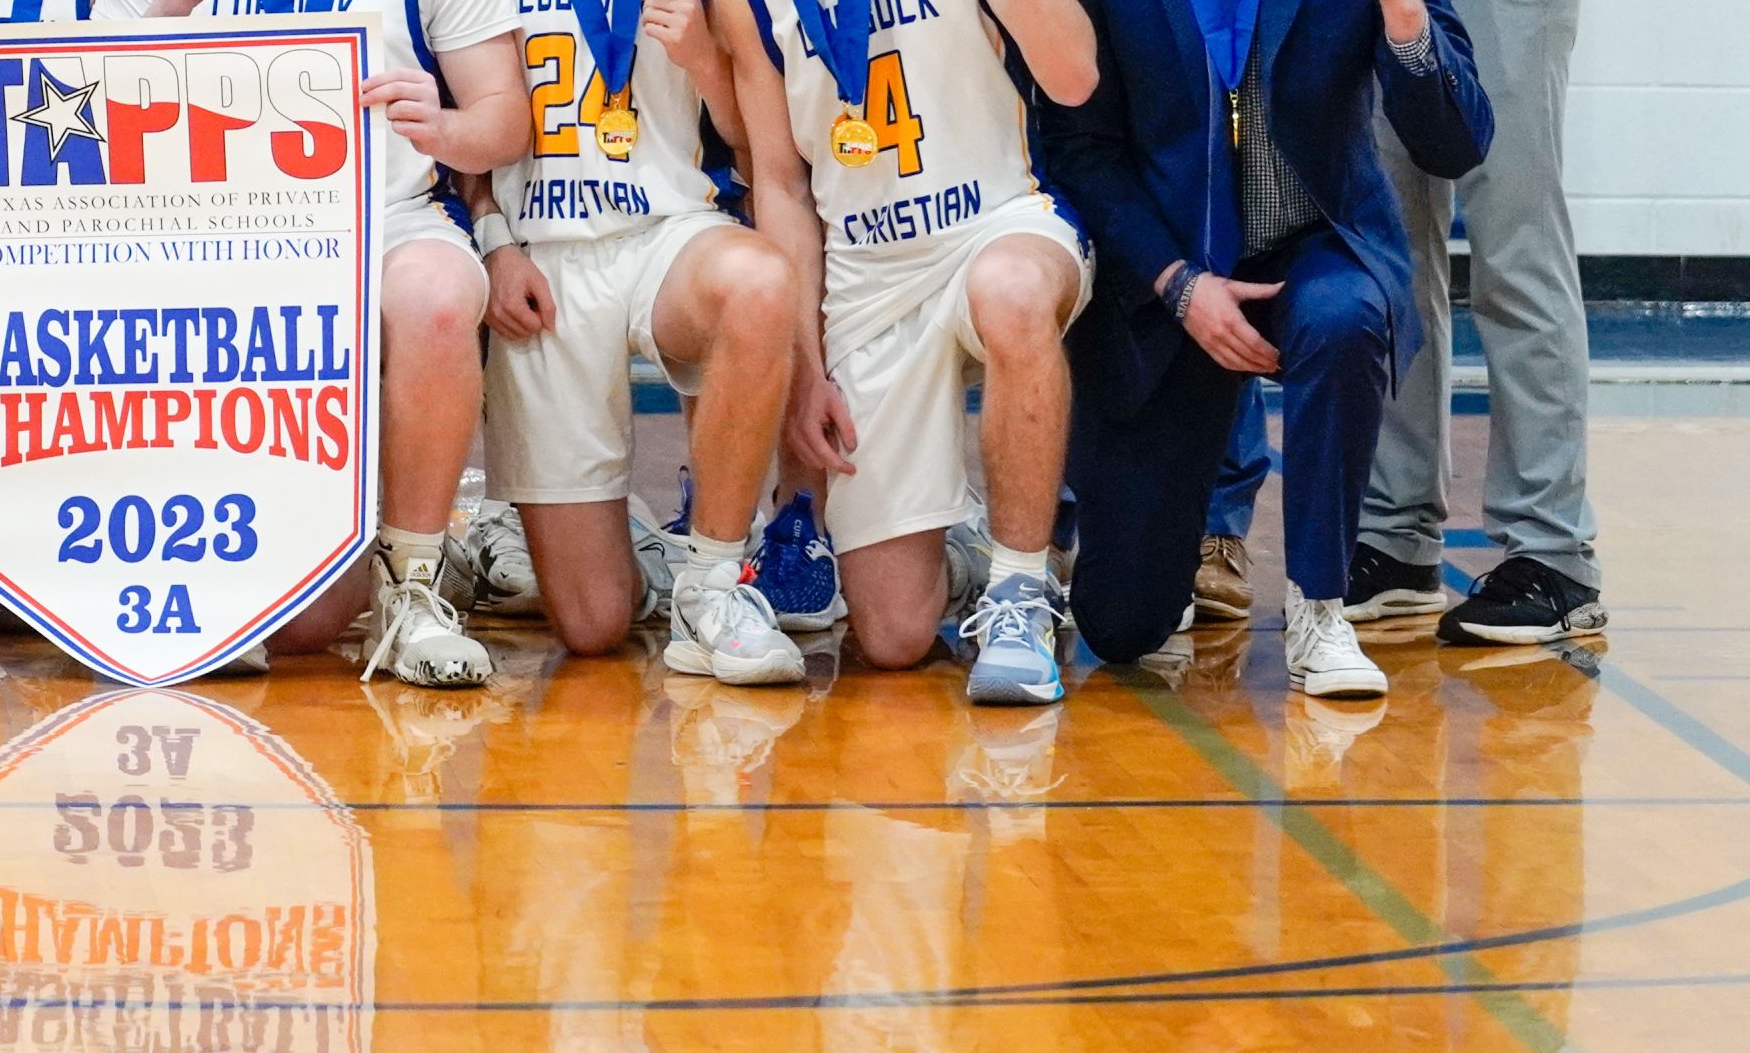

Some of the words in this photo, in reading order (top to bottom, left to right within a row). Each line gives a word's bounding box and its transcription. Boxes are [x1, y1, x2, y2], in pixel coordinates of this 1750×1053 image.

[525, 32, 639, 163] 24
[832, 50, 925, 178] 4
[1, 219, 50, 234] AND
[62, 217, 197, 233] PAROCHIAL
[208, 214, 315, 230] SCHOOLS
[53, 193, 201, 210] ASSOCIATION
[211, 193, 238, 207] OF
[248, 190, 340, 206] PRIVATE
[160, 240, 234, 262] WITH
[242, 237, 340, 261] HONOR
[58, 493, 258, 563] 2023
[116, 584, 201, 634] 3A
